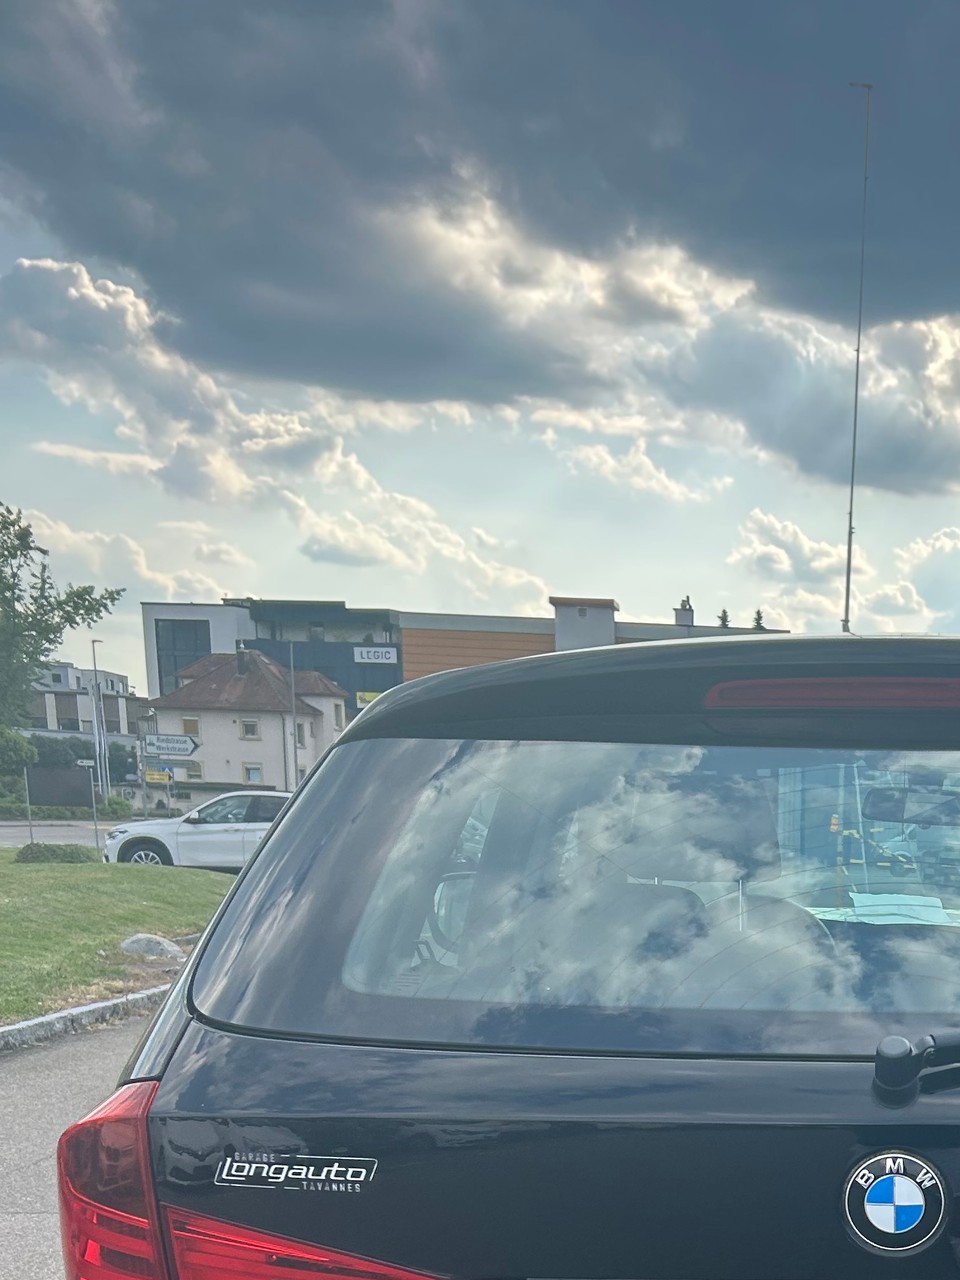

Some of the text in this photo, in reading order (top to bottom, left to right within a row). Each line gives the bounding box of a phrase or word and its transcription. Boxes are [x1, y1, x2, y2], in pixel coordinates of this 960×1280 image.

[360, 650, 391, 660] LEGIC
[234, 1152, 275, 1162] GARAGE
[222, 1157, 367, 1182] Longauto
[855, 1158, 936, 1189] BMW
[302, 1181, 361, 1193] TAVANNES
